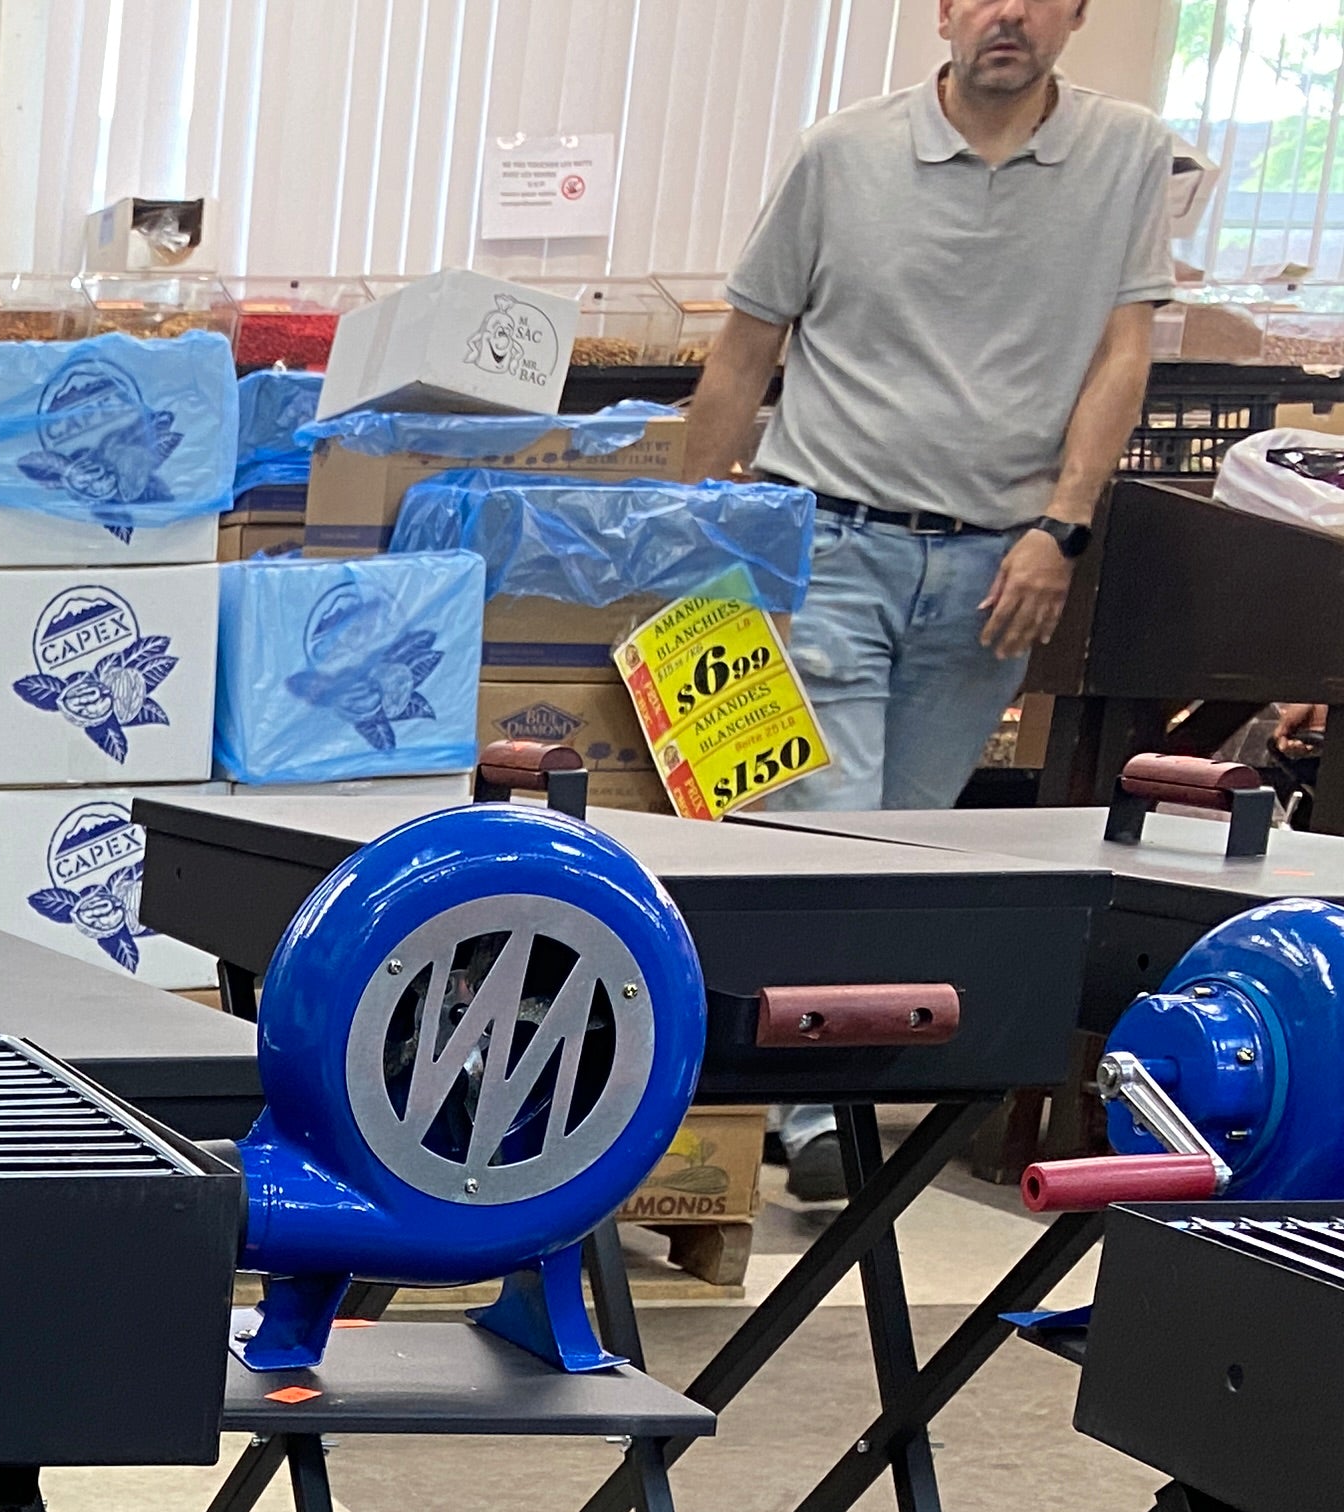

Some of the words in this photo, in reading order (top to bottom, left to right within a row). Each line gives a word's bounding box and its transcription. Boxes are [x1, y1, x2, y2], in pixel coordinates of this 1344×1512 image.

[516, 326, 543, 343] SAC
[519, 368, 547, 386] BAG
[42, 613, 130, 664] CAPEX
[654, 596, 711, 638] AMAND
[656, 599, 740, 661] BLANCHIES
[694, 682, 772, 736] AMANDES
[700, 701, 781, 753] BLANCHIES
[684, 777, 704, 813] PRIX
[714, 736, 811, 809] $150
[56, 828, 142, 878] CAPEX
